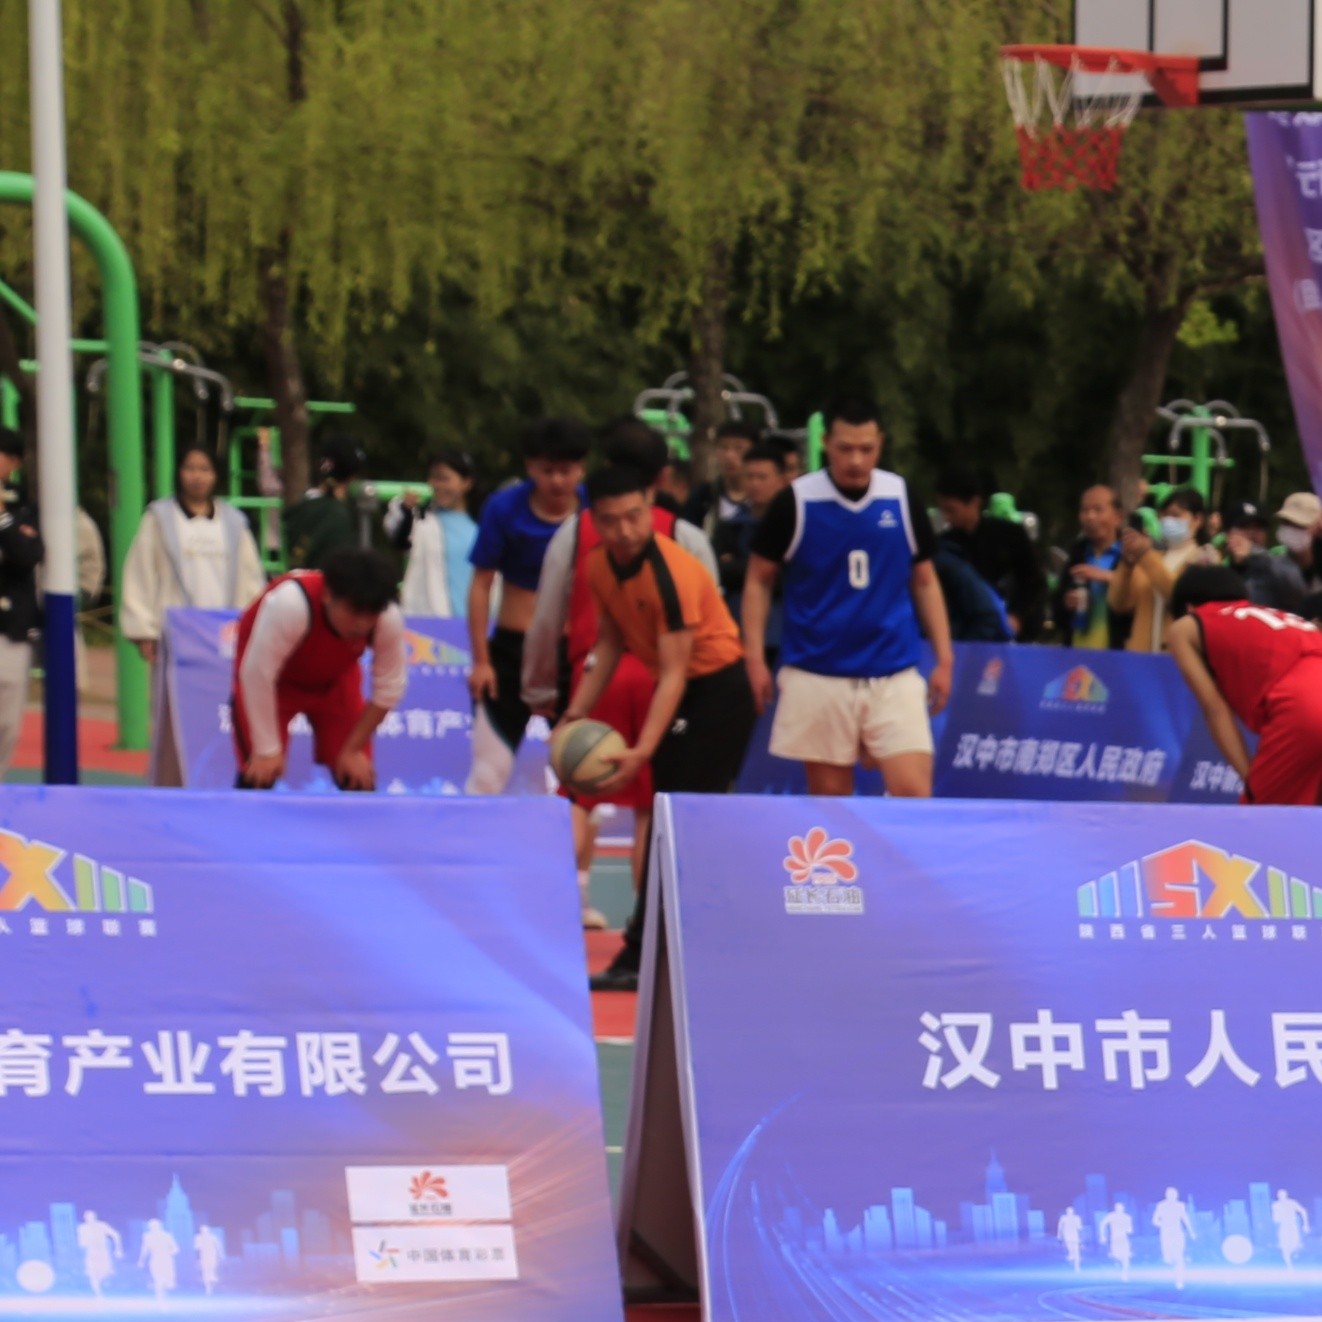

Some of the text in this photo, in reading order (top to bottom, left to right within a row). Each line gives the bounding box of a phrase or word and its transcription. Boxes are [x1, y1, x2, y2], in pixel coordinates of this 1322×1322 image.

[847, 549, 871, 589] 0
[0, 1029, 514, 1098] 育产业有限公司
